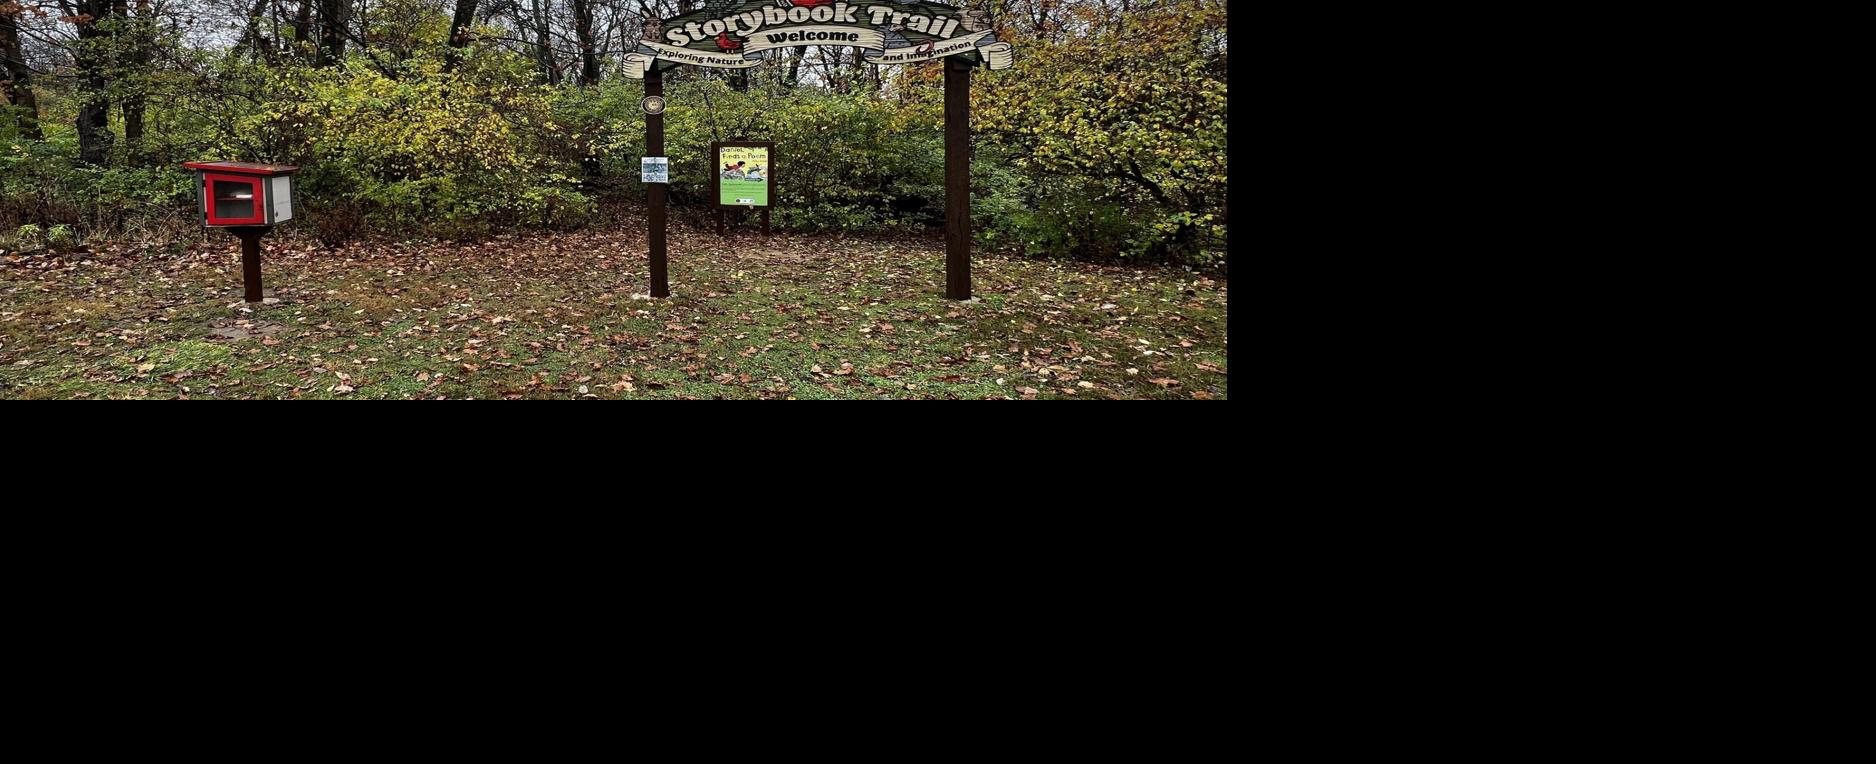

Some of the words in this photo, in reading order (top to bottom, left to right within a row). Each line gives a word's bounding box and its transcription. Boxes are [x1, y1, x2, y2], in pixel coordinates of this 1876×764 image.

[666, 3, 859, 47] Storybook
[867, 5, 960, 39] Trail
[766, 30, 859, 44] Welcome
[658, 47, 704, 64] Exploring
[707, 56, 745, 65] Nature
[883, 53, 903, 61] and
